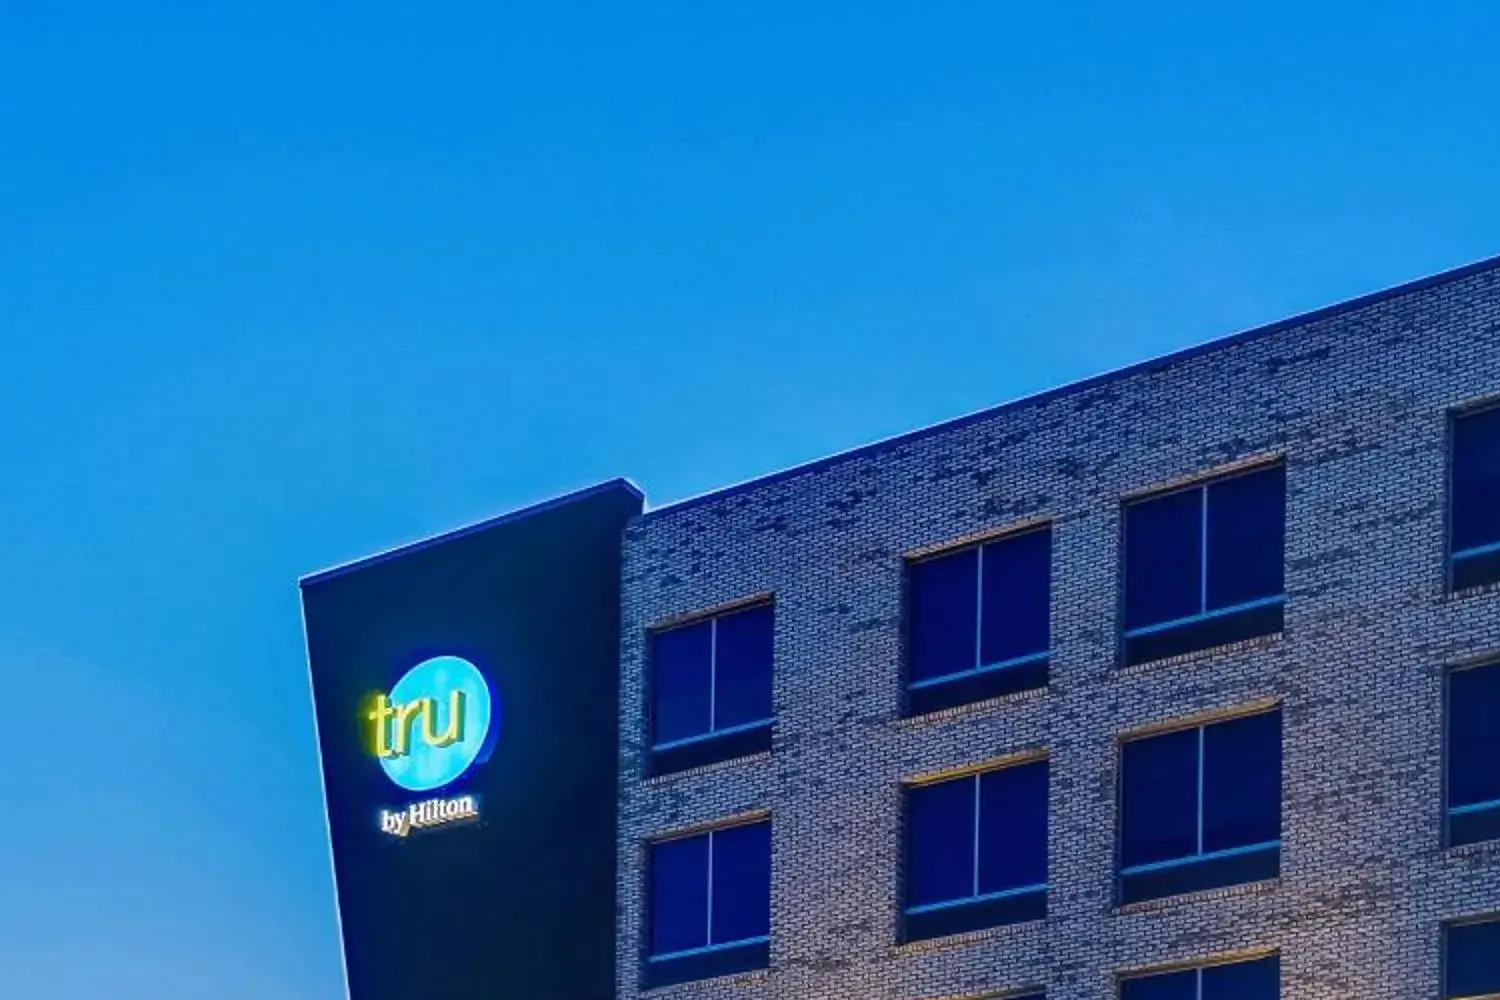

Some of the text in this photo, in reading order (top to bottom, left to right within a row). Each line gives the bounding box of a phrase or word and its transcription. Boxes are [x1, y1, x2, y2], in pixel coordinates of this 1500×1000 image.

[368, 690, 465, 758] tru
[381, 797, 477, 836] by Hilton
